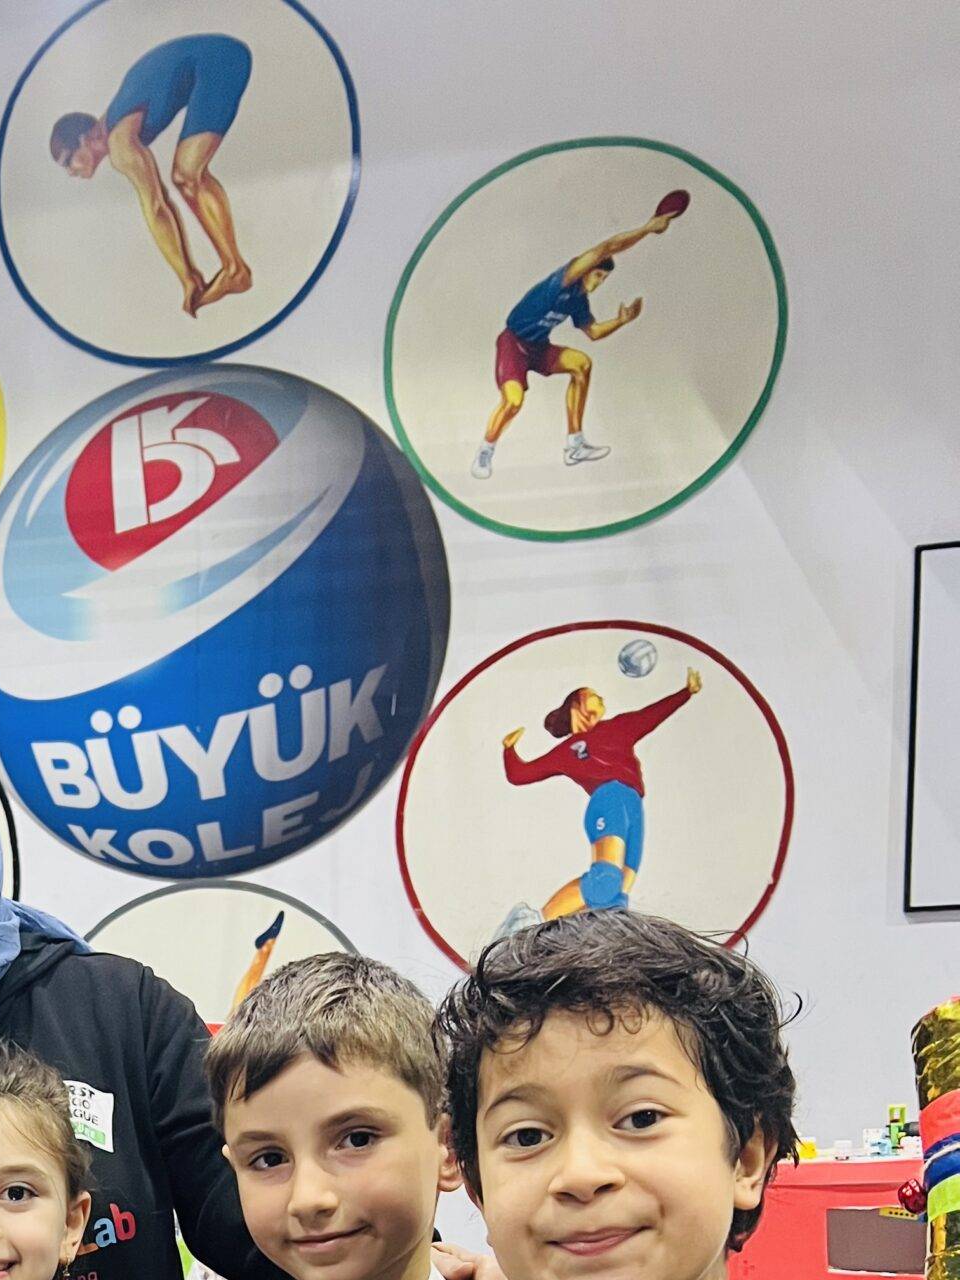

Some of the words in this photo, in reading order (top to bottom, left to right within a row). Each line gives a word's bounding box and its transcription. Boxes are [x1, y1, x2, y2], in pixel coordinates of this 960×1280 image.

[30, 664, 388, 811] BÜYÜK
[67, 760, 375, 867] KOLEJ
[73, 1109, 100, 1125] GUE
